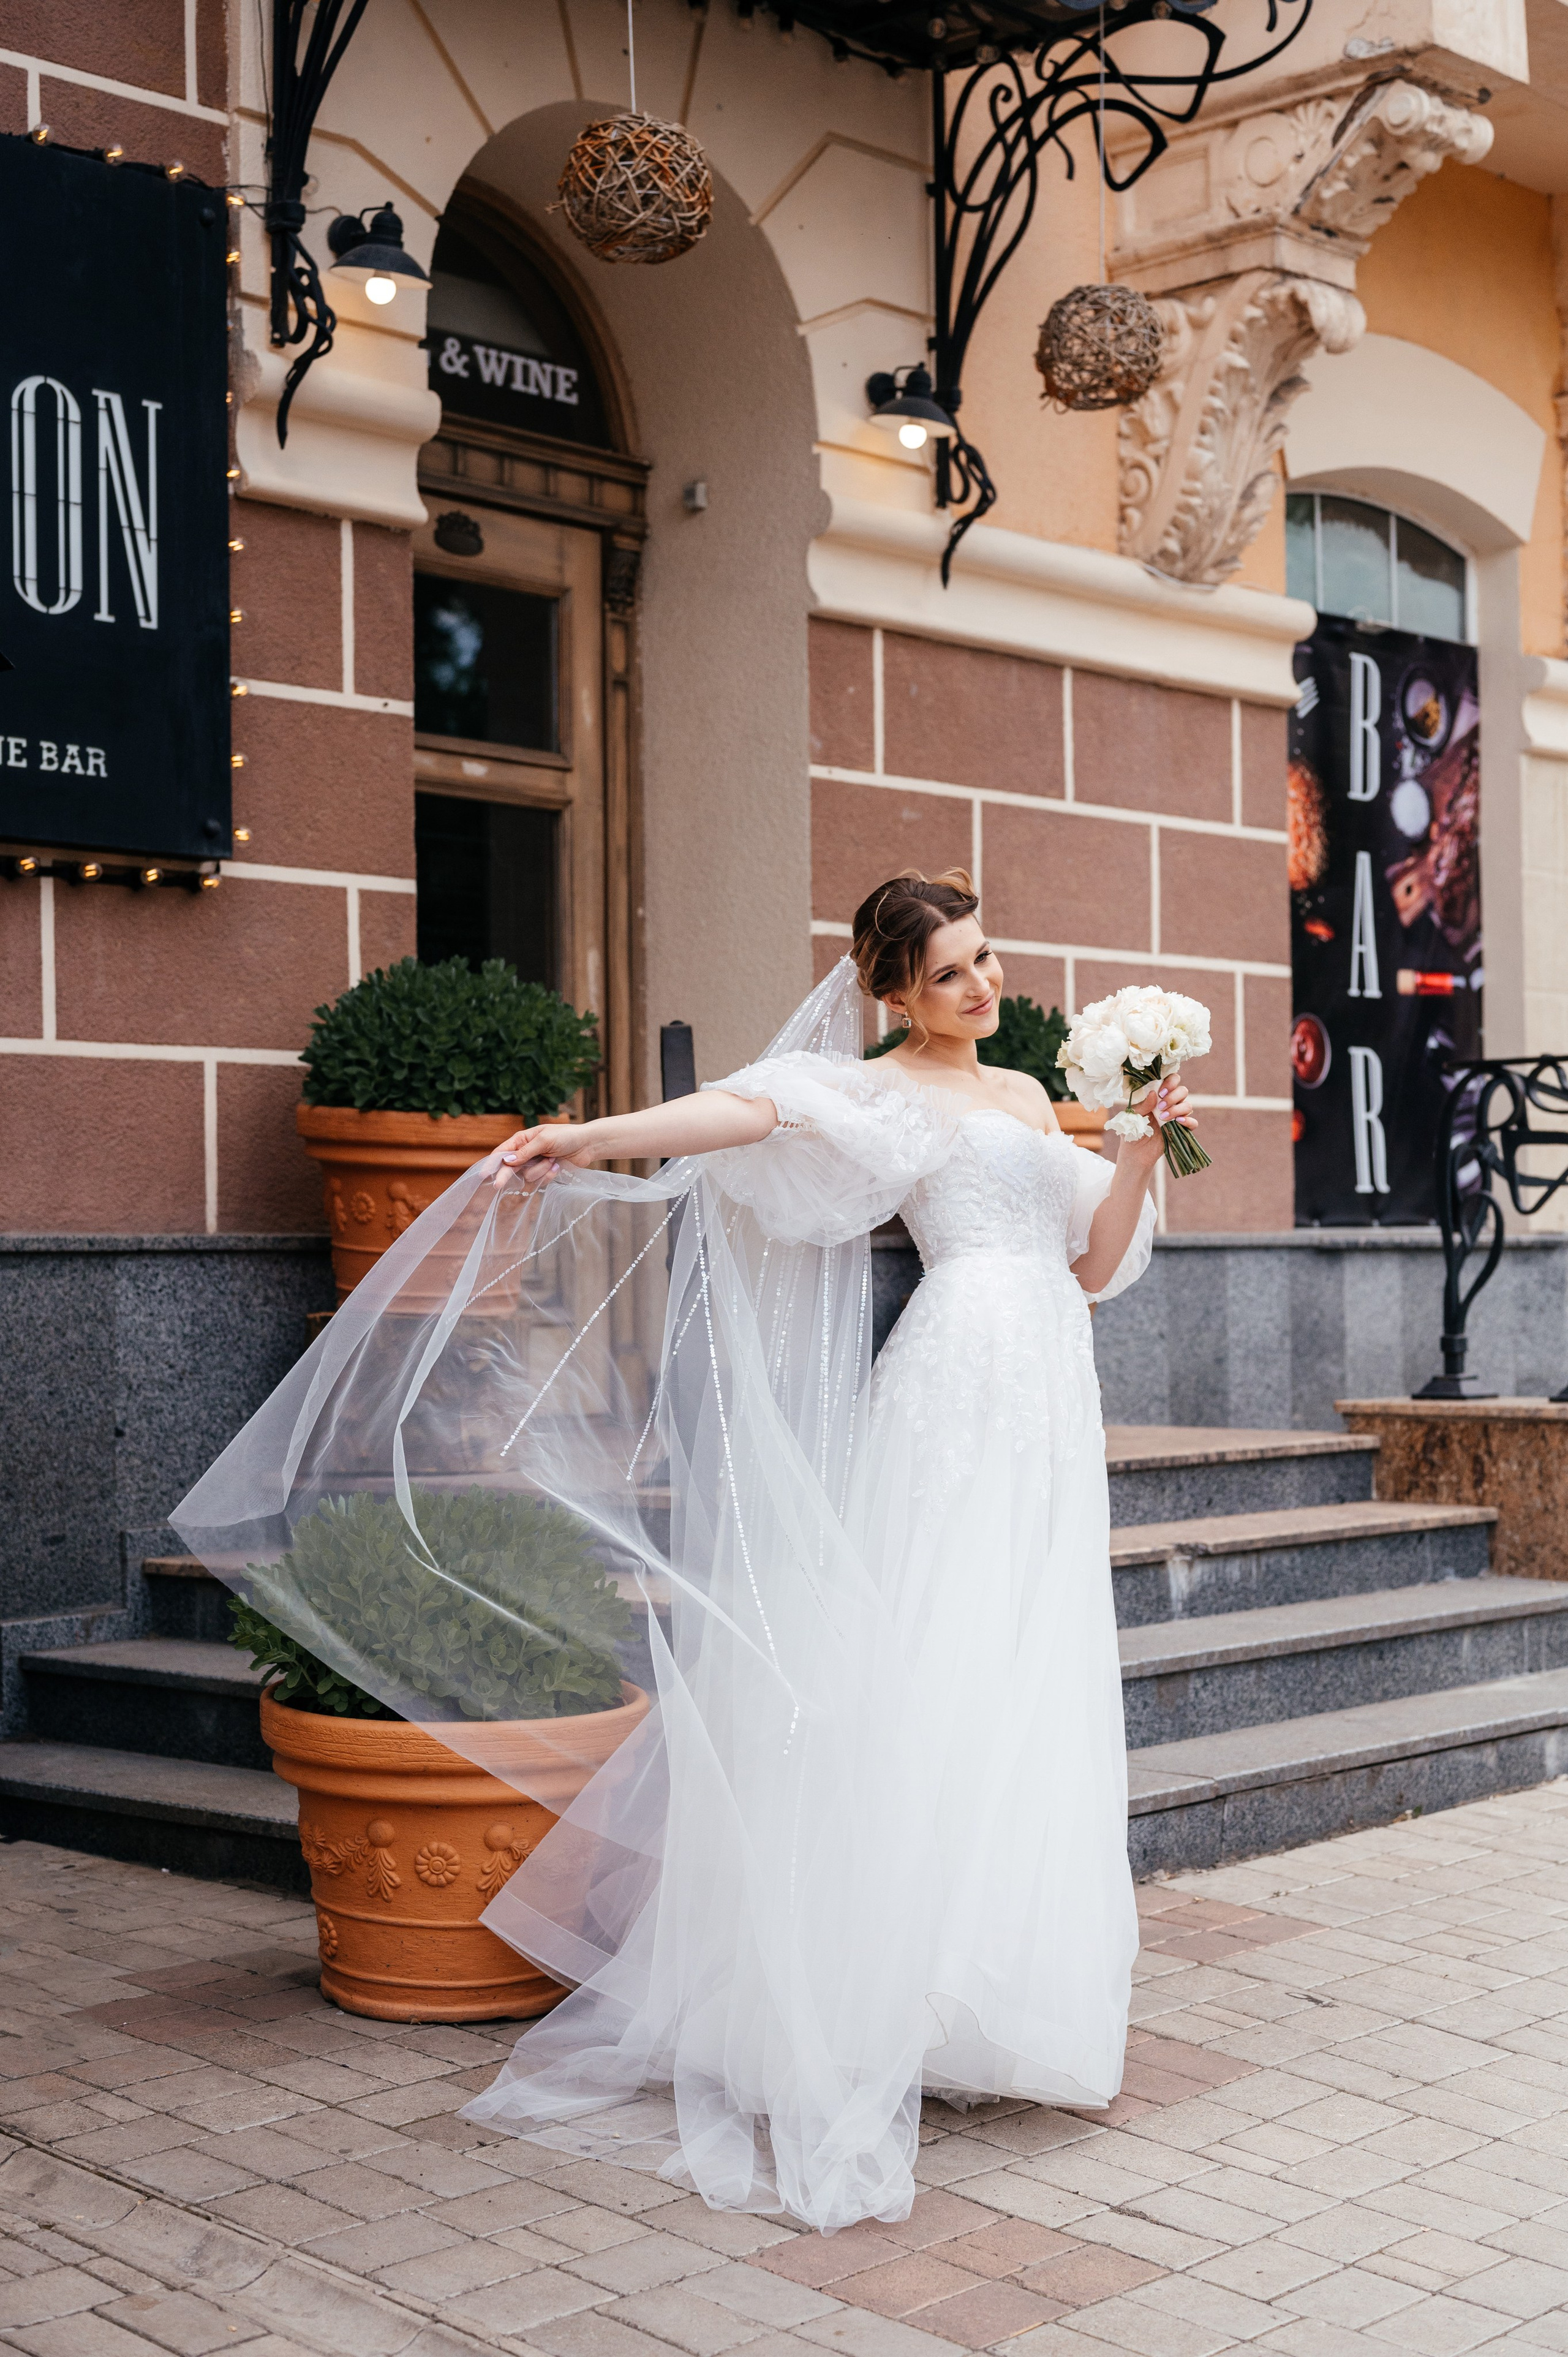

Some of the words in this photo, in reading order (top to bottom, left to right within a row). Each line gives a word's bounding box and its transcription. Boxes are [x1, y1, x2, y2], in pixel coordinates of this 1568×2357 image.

[439, 337, 470, 378] &
[472, 344, 579, 405] WINE
[11, 375, 163, 630] ON
[0, 736, 28, 768] E
[39, 740, 108, 778] BAR
[1347, 652, 1391, 1194] BAR
